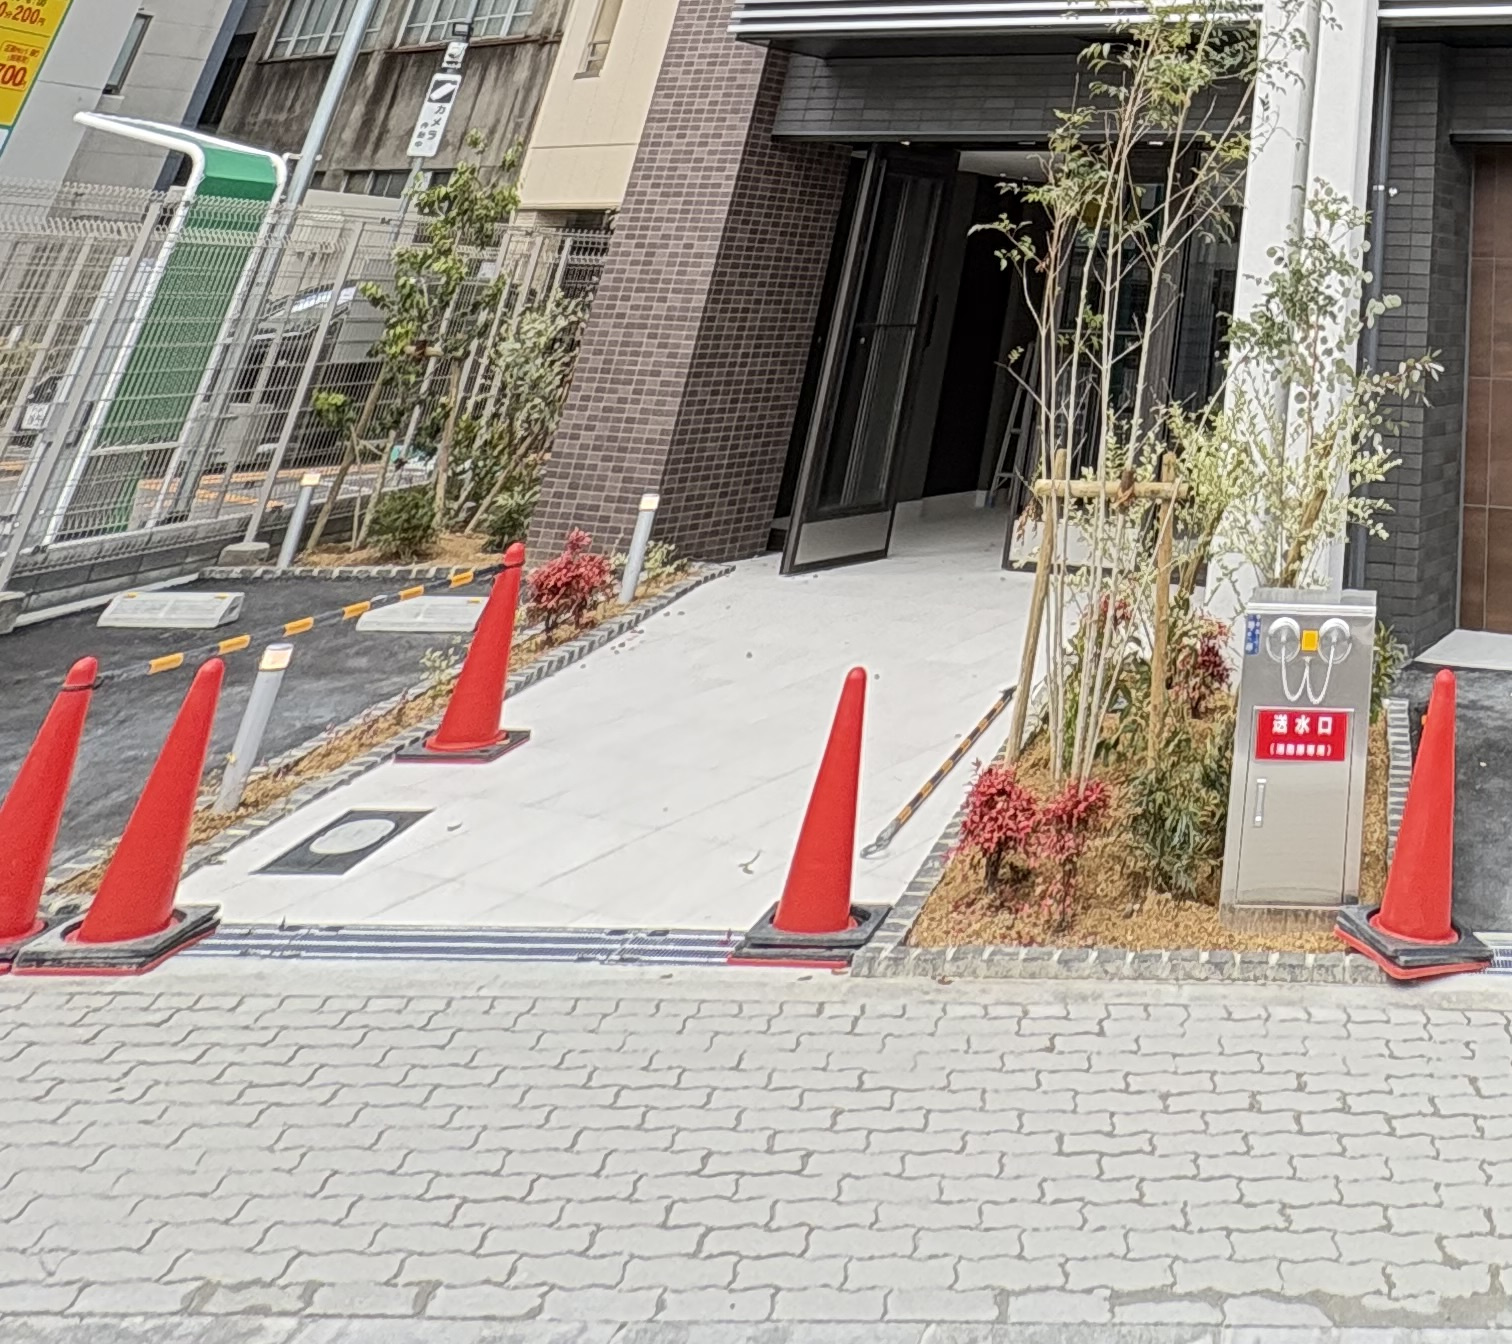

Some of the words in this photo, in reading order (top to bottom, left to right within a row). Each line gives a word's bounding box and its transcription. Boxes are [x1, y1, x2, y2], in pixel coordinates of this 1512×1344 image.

[427, 105, 446, 141] カメラ
[1271, 713, 1334, 736] 送水口
